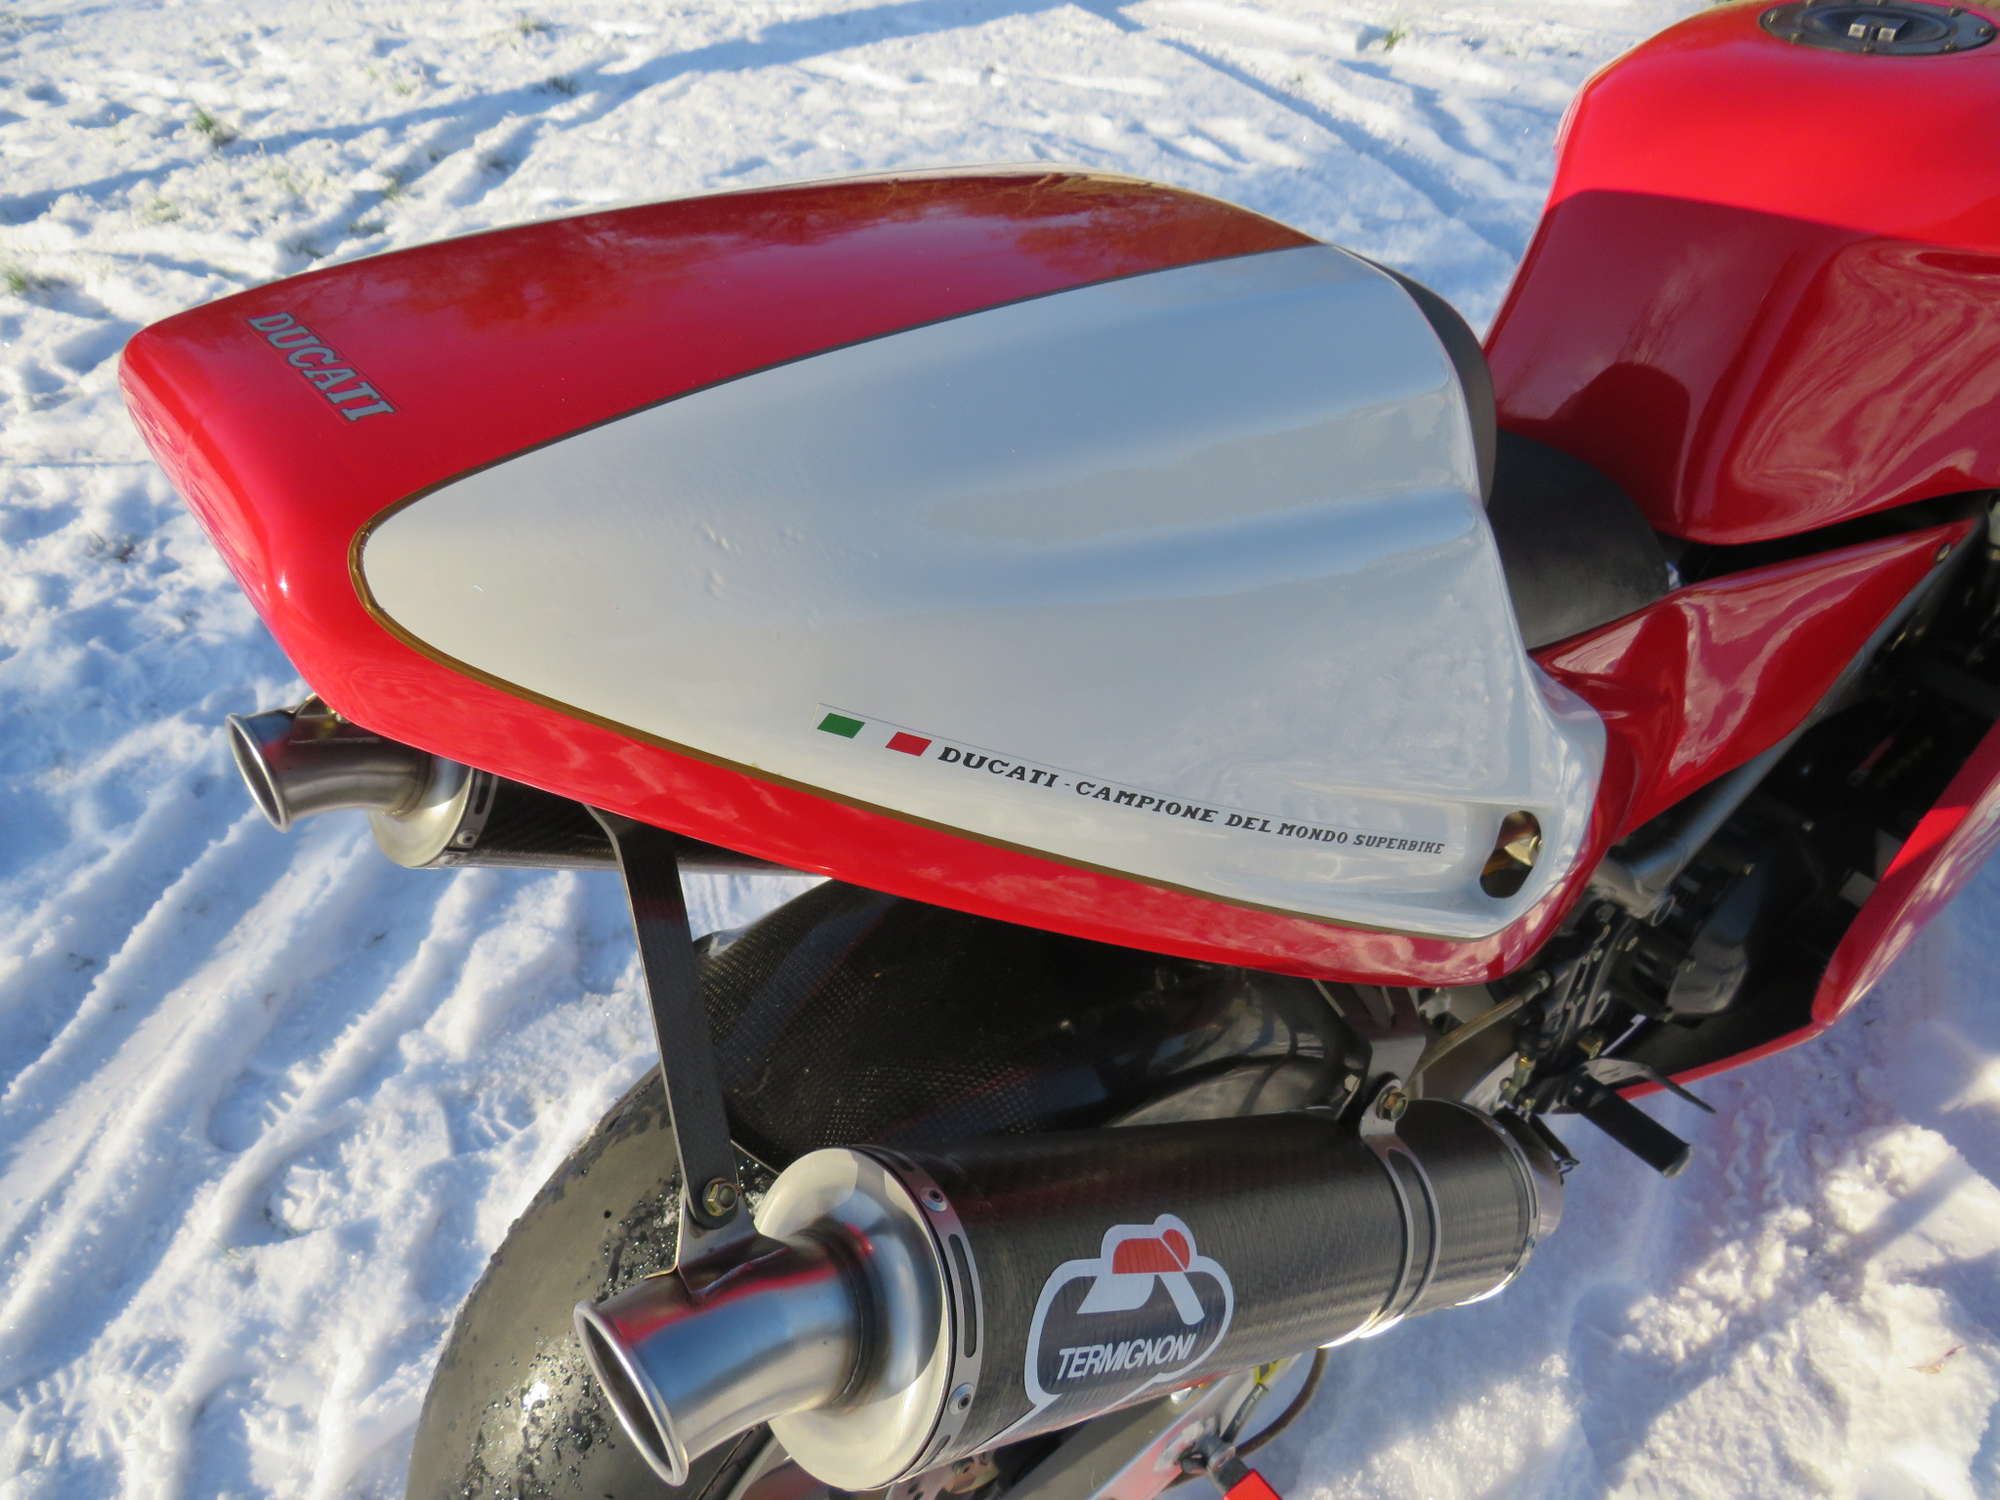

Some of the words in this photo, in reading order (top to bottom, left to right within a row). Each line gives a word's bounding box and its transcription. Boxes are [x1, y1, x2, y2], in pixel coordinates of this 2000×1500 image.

[247, 311, 396, 421] DUCATI
[937, 746, 1060, 788] DUCATI
[1075, 781, 1219, 823] CAMPIONE
[1224, 813, 1273, 833] DEL
[1277, 822, 1349, 844] MONDO
[1352, 834, 1446, 855] SUPERBIKE
[1056, 1333, 1197, 1381] TERMIGNONI
